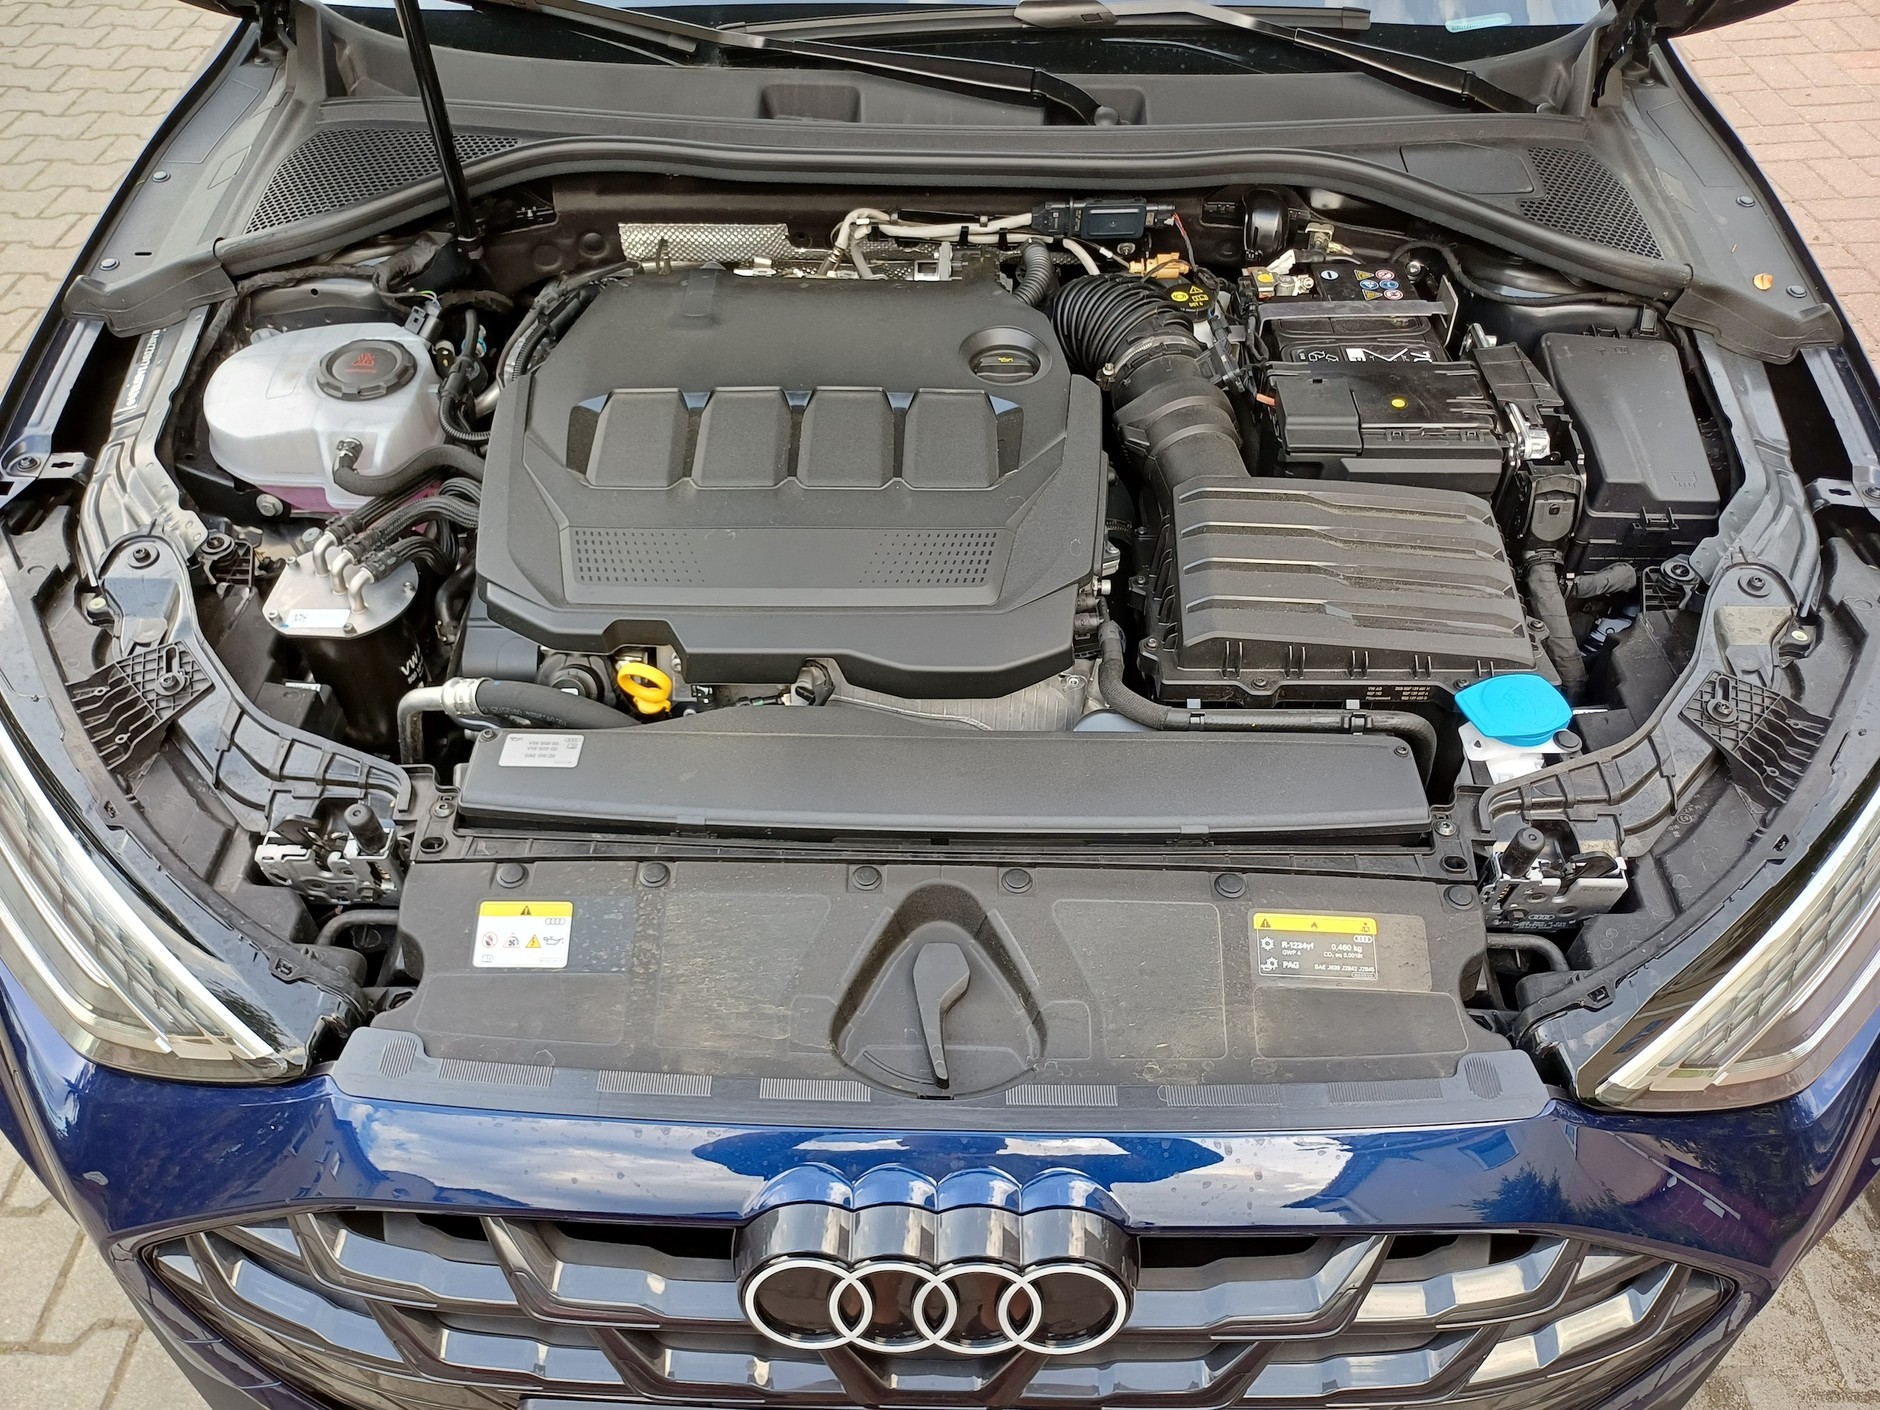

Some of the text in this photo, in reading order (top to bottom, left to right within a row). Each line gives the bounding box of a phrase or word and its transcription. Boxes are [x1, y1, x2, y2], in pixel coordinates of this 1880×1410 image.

[401, 651, 418, 676] VW
[1281, 941, 1314, 951] R-1234yf
[1354, 945, 1363, 953] kg
